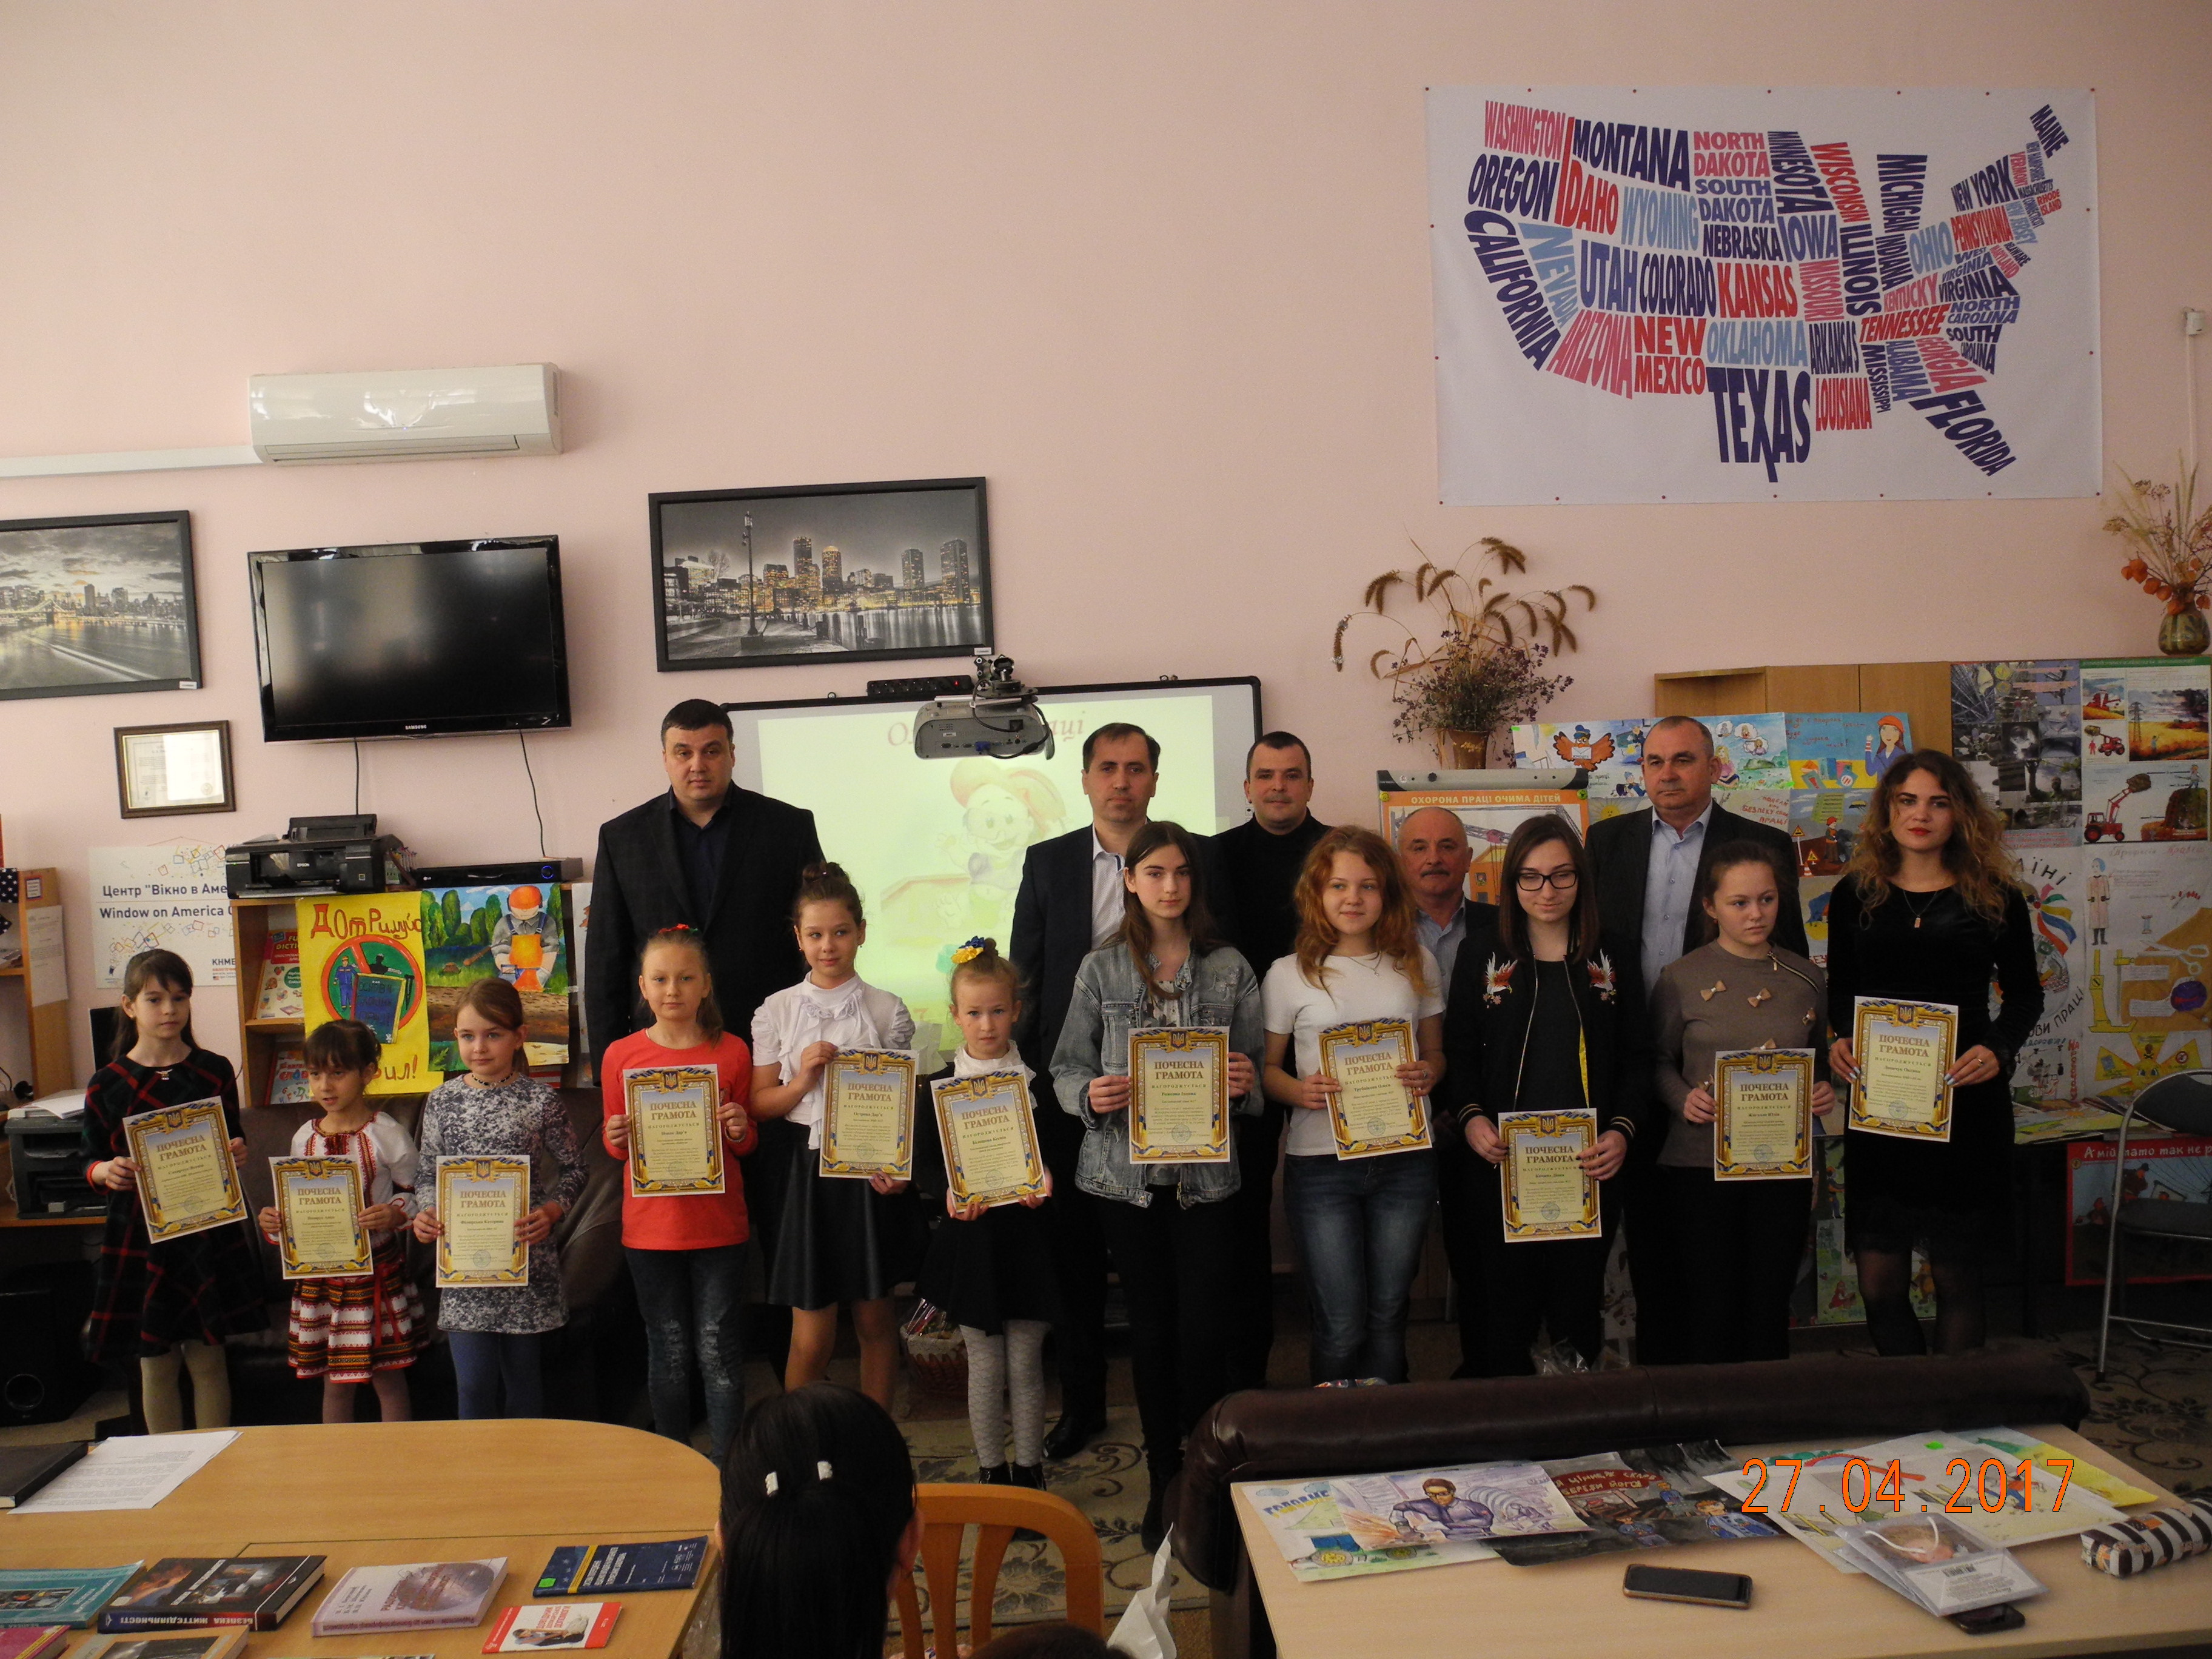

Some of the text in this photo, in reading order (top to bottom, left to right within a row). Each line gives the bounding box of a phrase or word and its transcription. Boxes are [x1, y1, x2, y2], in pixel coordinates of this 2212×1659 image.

[1485, 101, 1566, 160] WASHINGTON
[1694, 131, 1765, 150] NORTH
[2030, 104, 2070, 159] MAINE
[1574, 119, 1690, 192] MONTANA
[1694, 152, 1771, 177] DAKOTA
[1768, 131, 1834, 214] MINNESOTA
[1468, 153, 1559, 221] OREGON
[1554, 116, 1618, 235] IDAHO
[1695, 179, 1772, 196] SOUTH
[1811, 142, 1871, 223] WISCONSIN
[1951, 155, 2019, 212] NEW YORK
[1877, 154, 1928, 233] MICHIGAN
[2037, 189, 2060, 205] RHODE
[2040, 199, 2062, 216] ISLAND
[1621, 186, 1698, 251] WYOMING
[1698, 198, 1775, 224] DAKOTA
[1703, 224, 1783, 261] NEBRASKA
[1777, 215, 1838, 262] IOWA
[1950, 205, 2014, 253] PENNSYLVANIA
[1875, 233, 1913, 290] INDIANA
[1909, 221, 1953, 275] OHIO
[1954, 247, 1986, 264] WEST
[1518, 223, 1578, 328] NEVADA
[1580, 240, 1638, 313] UTAH
[1840, 224, 1882, 317] ILLINOIS
[1939, 265, 2020, 303] VIRGINIA
[1942, 251, 1995, 283] VIRGINIA
[1464, 210, 1561, 370] CALIFORNIA
[1640, 253, 1716, 317] COLORADO
[1717, 263, 1798, 318] KANSAS
[1799, 260, 1845, 322] MISSOURI
[1884, 272, 1939, 313] KENTUCKY
[1947, 310, 2018, 324] CAROLINA
[1950, 297, 2020, 313] NORTH
[1634, 316, 1706, 355] NEW
[1860, 304, 1951, 343] TENNESSEE
[1946, 324, 2002, 343] SOUTH
[1546, 309, 1633, 399] ARIZONA
[1706, 321, 1809, 367] OKLAHOMA
[1809, 321, 1860, 375] ARKANSAS
[1961, 343, 1996, 375] CAROLINA
[1635, 356, 1706, 395] MEXICO
[1861, 344, 1891, 414] MISSISSIPPI
[1886, 340, 1931, 401] ALABAMA
[1915, 337, 1987, 393] GEORGIA
[1815, 377, 1872, 431] LOUISIANA
[1706, 367, 1811, 483] TEXAS
[1908, 389, 2017, 477] FLORIDA
[1462, 796, 1492, 804] ПРАЦІ
[1533, 793, 1561, 803] ДІТЕЙ
[103, 885, 141, 898] Центр
[145, 883, 187, 896] "Вікно
[202, 883, 228, 894] Аме
[99, 905, 224, 919] Window on America
[2054, 988, 2085, 1028] ПРАЦІ
[1879, 1034, 1930, 1047] ПОЧЕСНА
[1879, 1045, 1929, 1057] ГРАМОТА
[1155, 1061, 1205, 1070] ПОЧЕСНА
[1156, 1071, 1204, 1079] ГРАМОТА
[1344, 1052, 1392, 1065] ПОЧЕСНА
[1347, 1062, 1393, 1076] ГРАМОТА
[848, 1083, 893, 1092] ПОЧЕСНА
[848, 1093, 892, 1102] ГРАМОТА
[1740, 1082, 1789, 1091] ПОЧЕСНА
[1741, 1093, 1789, 1102] ГРАМОТА
[650, 1101, 697, 1111] ПОЧЕСНА
[651, 1111, 697, 1121] ГРАМОТА
[962, 1105, 1008, 1120] ПОЧЕСНА
[964, 1114, 1010, 1130] ГРАМОТА
[156, 1134, 206, 1152] ПОЧЕСНА
[159, 1144, 207, 1162] ГРАМОТА
[1525, 1145, 1574, 1154] ПОЧЕСНА
[1527, 1155, 1574, 1164] ГРАМОТА
[298, 1187, 341, 1196] ПОЧЕСНА
[299, 1196, 342, 1205] ГРАМОТА
[460, 1190, 506, 1199] ПОЧЕСНА
[212, 1616, 253, 1625] БЕЗПЕКА
